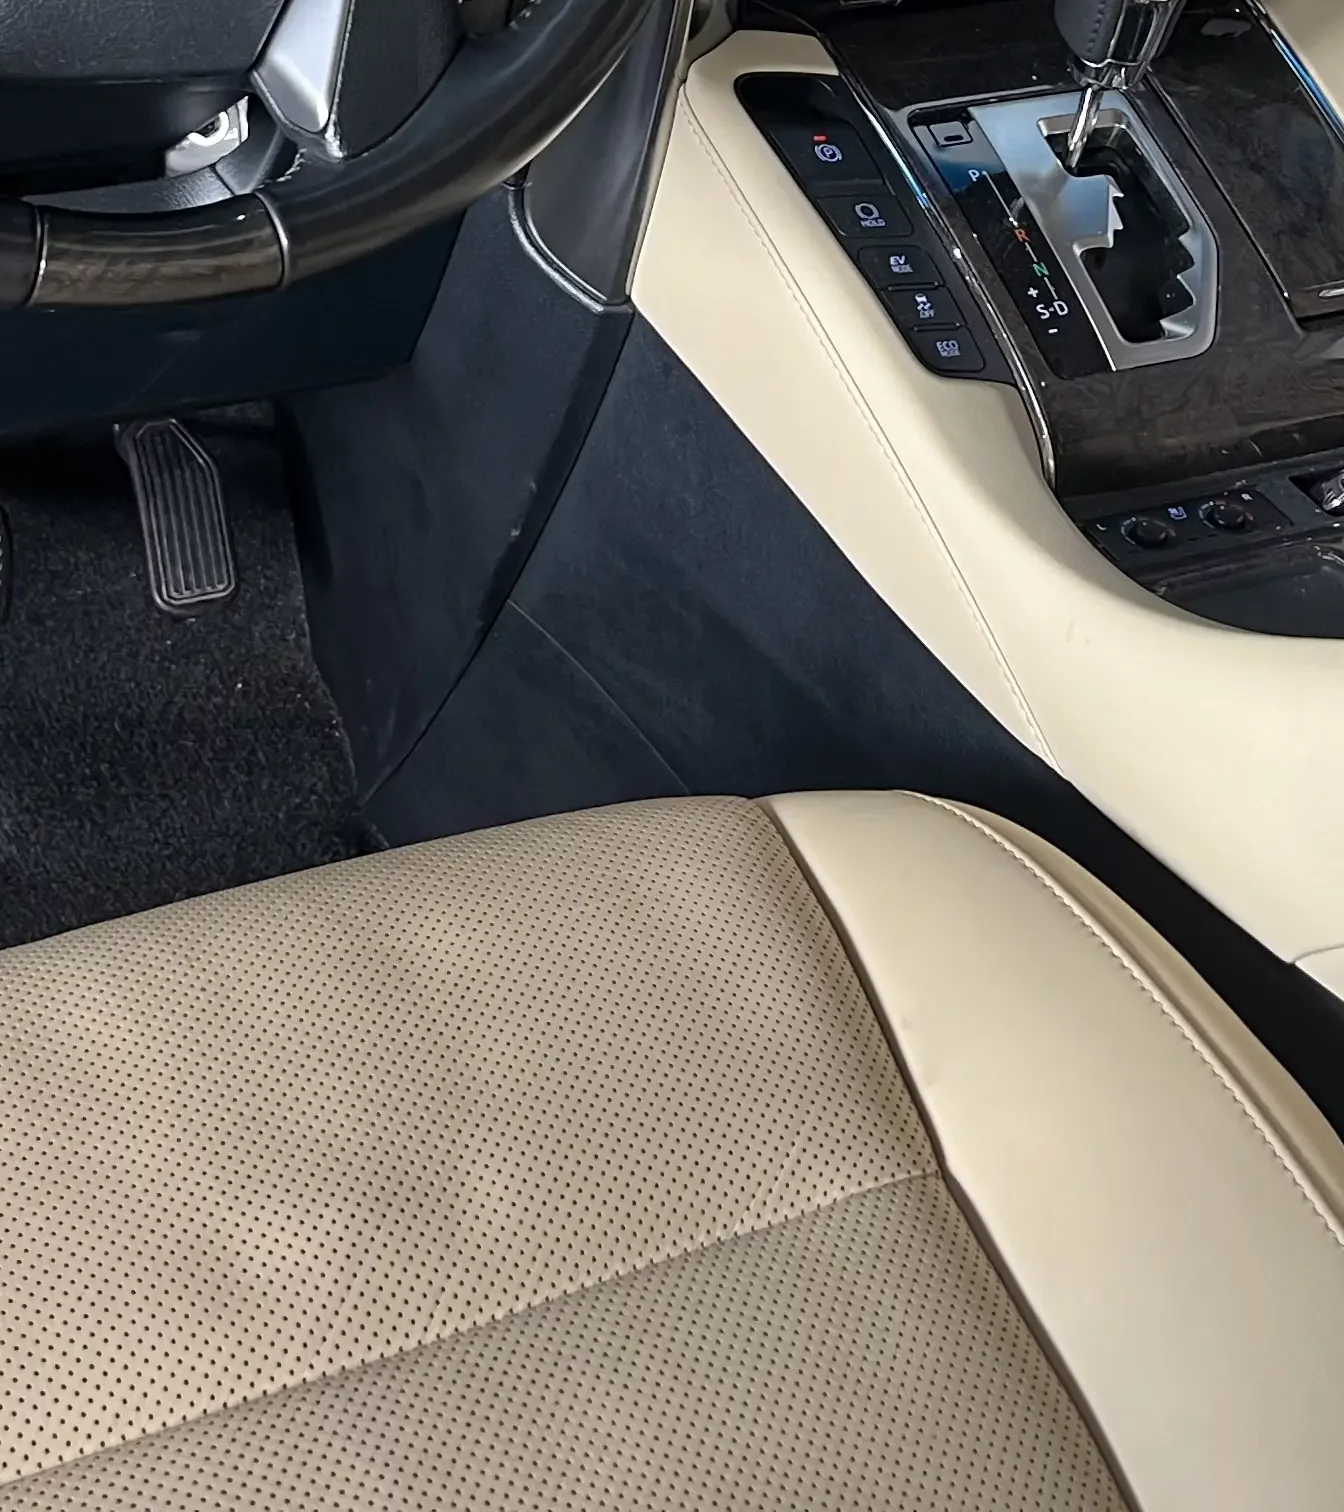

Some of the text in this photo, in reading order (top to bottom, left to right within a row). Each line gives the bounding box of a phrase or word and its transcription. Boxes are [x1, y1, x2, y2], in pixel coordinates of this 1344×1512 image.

[968, 169, 981, 182] P
[1014, 228, 1031, 243] R
[889, 255, 906, 265] EV
[1032, 262, 1050, 277] N
[936, 340, 958, 350] ECO
